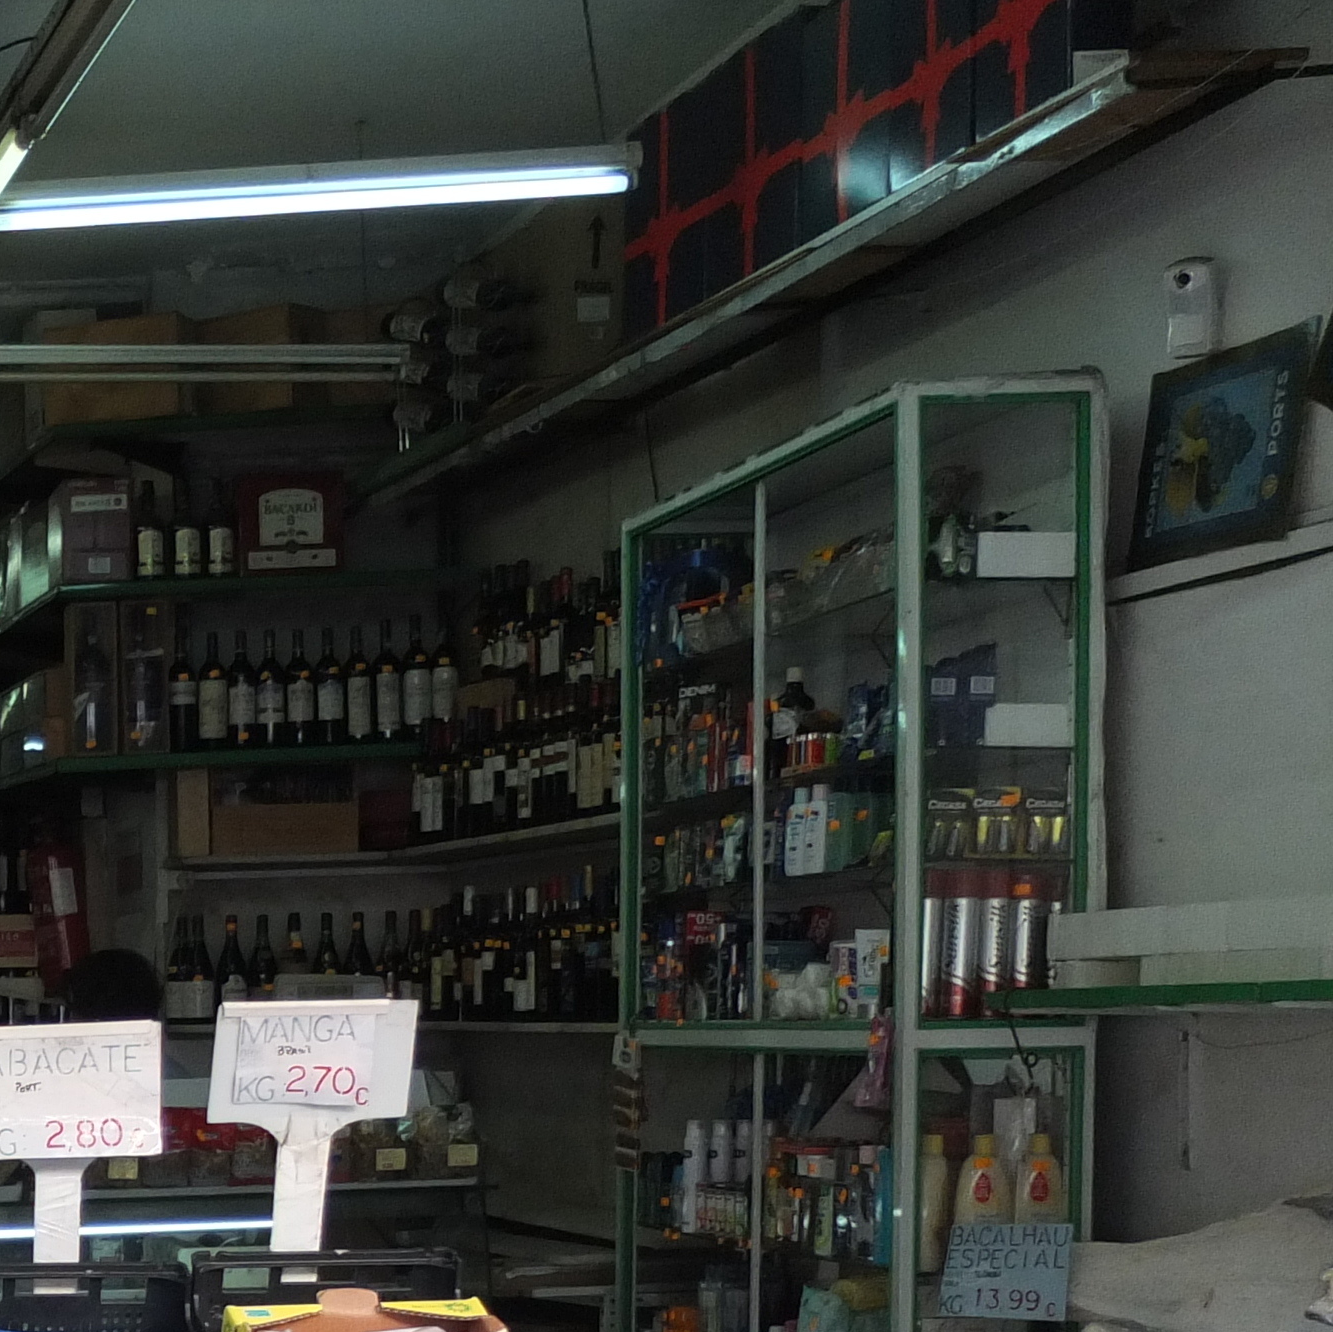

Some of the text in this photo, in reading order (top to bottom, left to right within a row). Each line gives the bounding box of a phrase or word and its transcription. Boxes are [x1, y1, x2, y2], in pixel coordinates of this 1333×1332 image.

[241, 1015, 356, 1045] MANGA
[285, 1065, 356, 1097] 2,70
[45, 1118, 123, 1152] 2,80
[949, 1225, 1073, 1248] BACALHAU
[945, 1248, 1065, 1271] ESPECIAL
